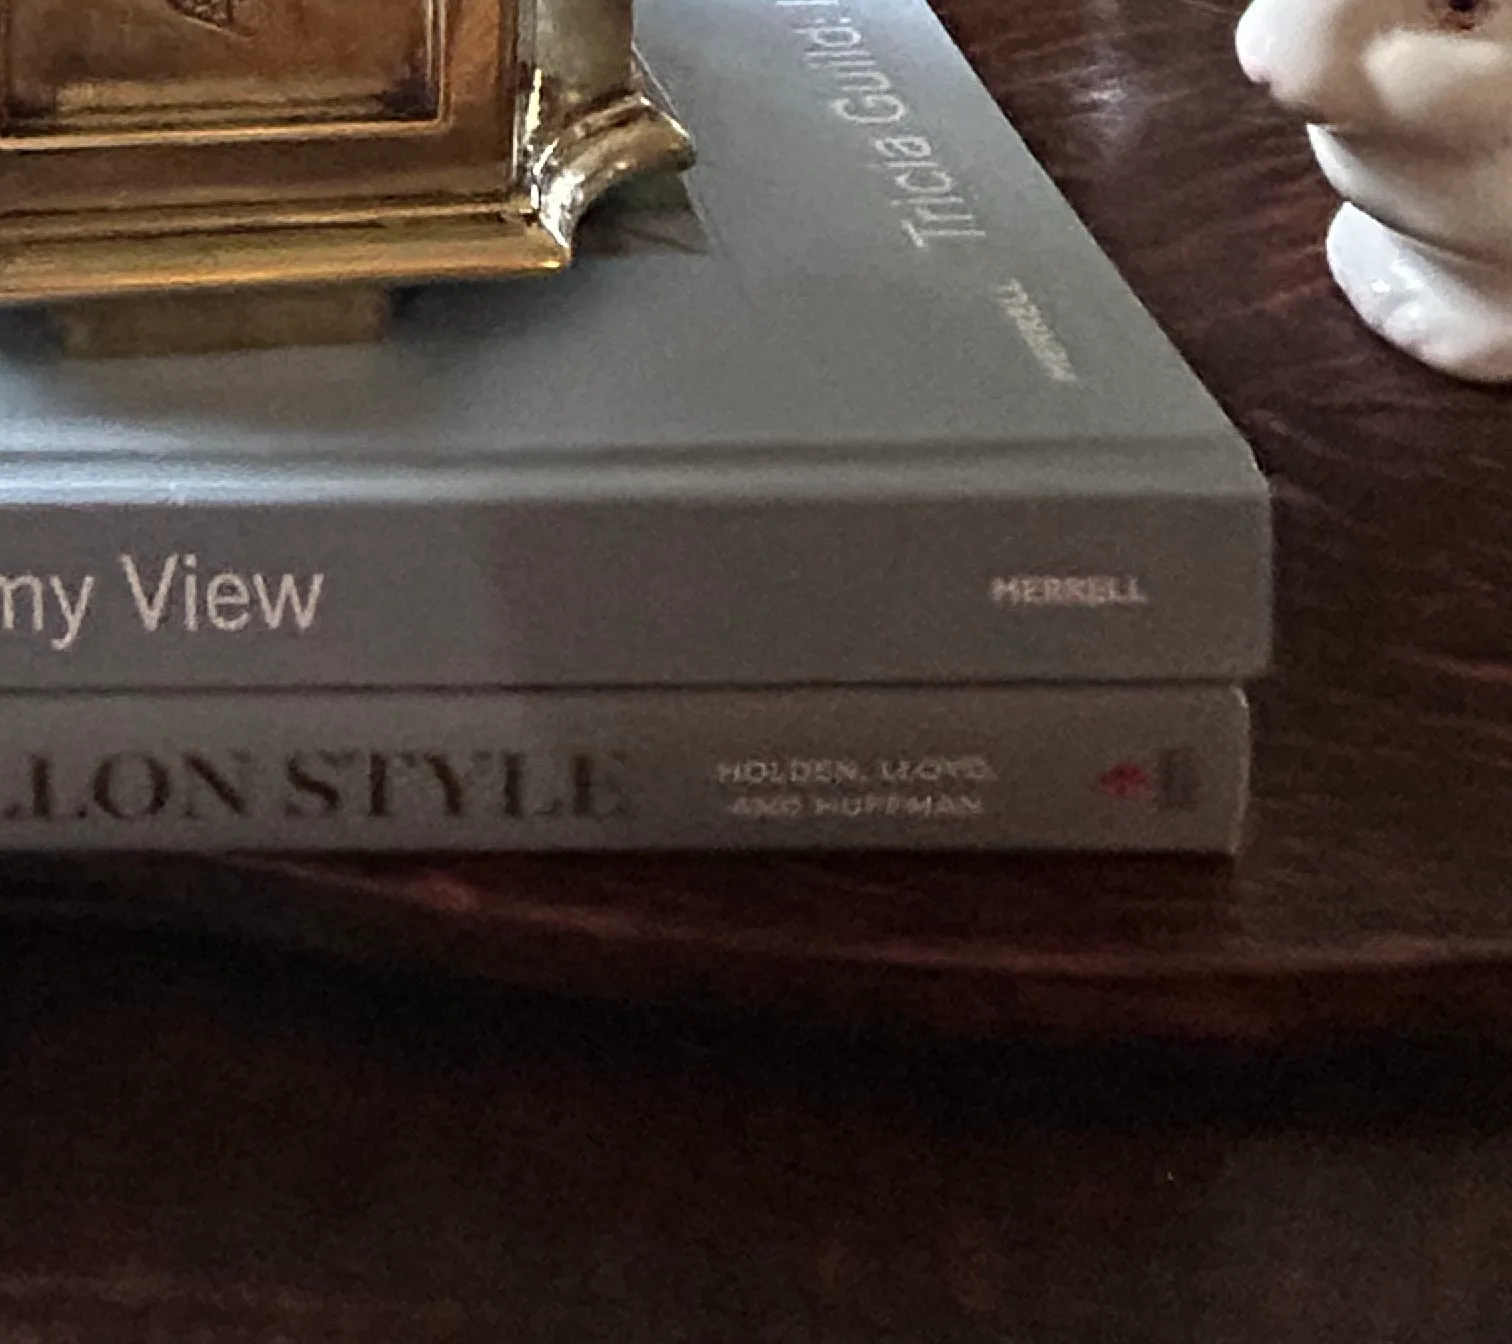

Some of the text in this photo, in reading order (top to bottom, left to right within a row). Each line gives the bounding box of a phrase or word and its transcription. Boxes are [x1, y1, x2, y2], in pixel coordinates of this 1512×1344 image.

[791, 15, 908, 124] Guild:
[869, 134, 987, 250] Tricia
[119, 551, 325, 633] View
[287, 746, 631, 818] STYLE
